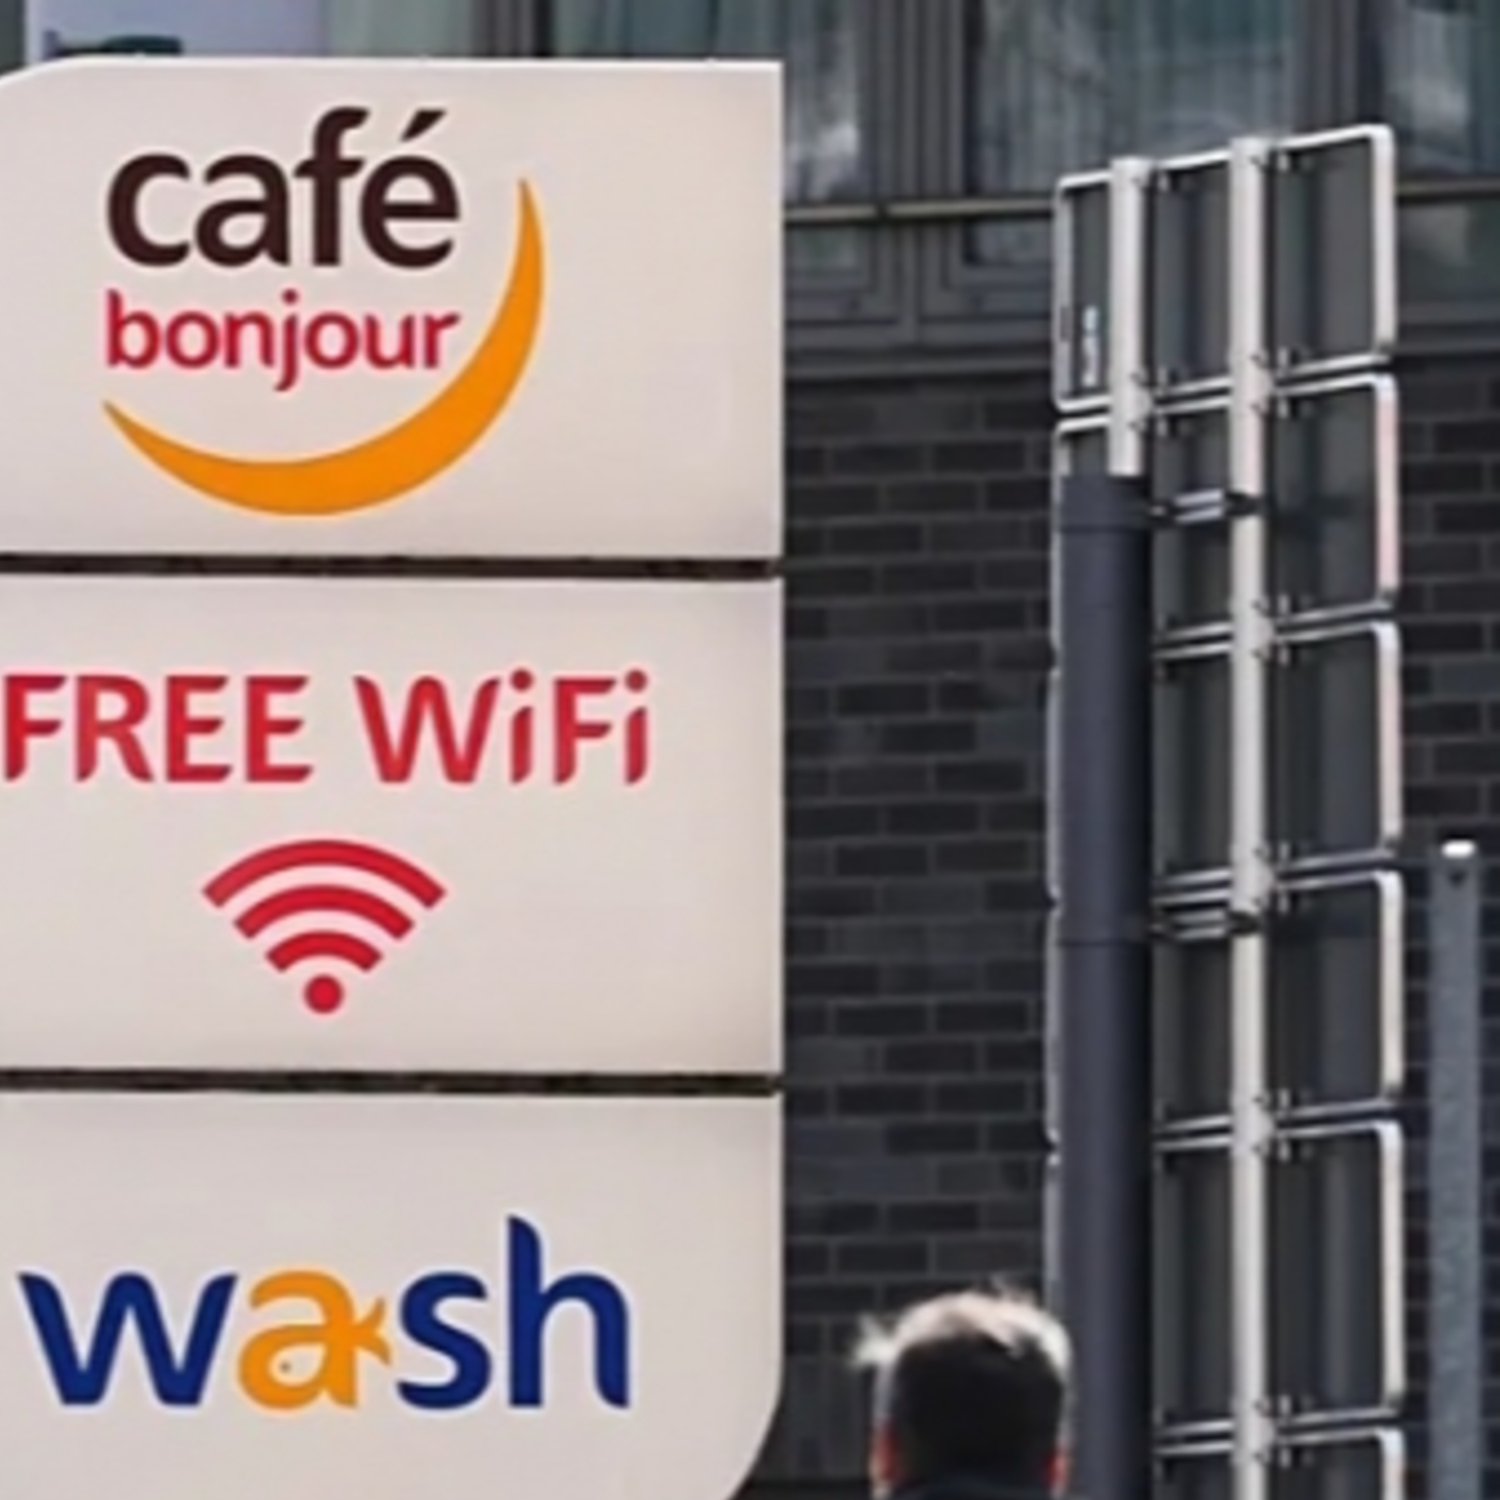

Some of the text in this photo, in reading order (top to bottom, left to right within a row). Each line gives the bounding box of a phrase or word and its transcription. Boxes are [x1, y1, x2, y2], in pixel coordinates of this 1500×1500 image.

[105, 105, 461, 270] café
[105, 289, 460, 391] bonjour
[1, 668, 651, 786] FREE WiFi
[17, 1214, 632, 1411] wash
